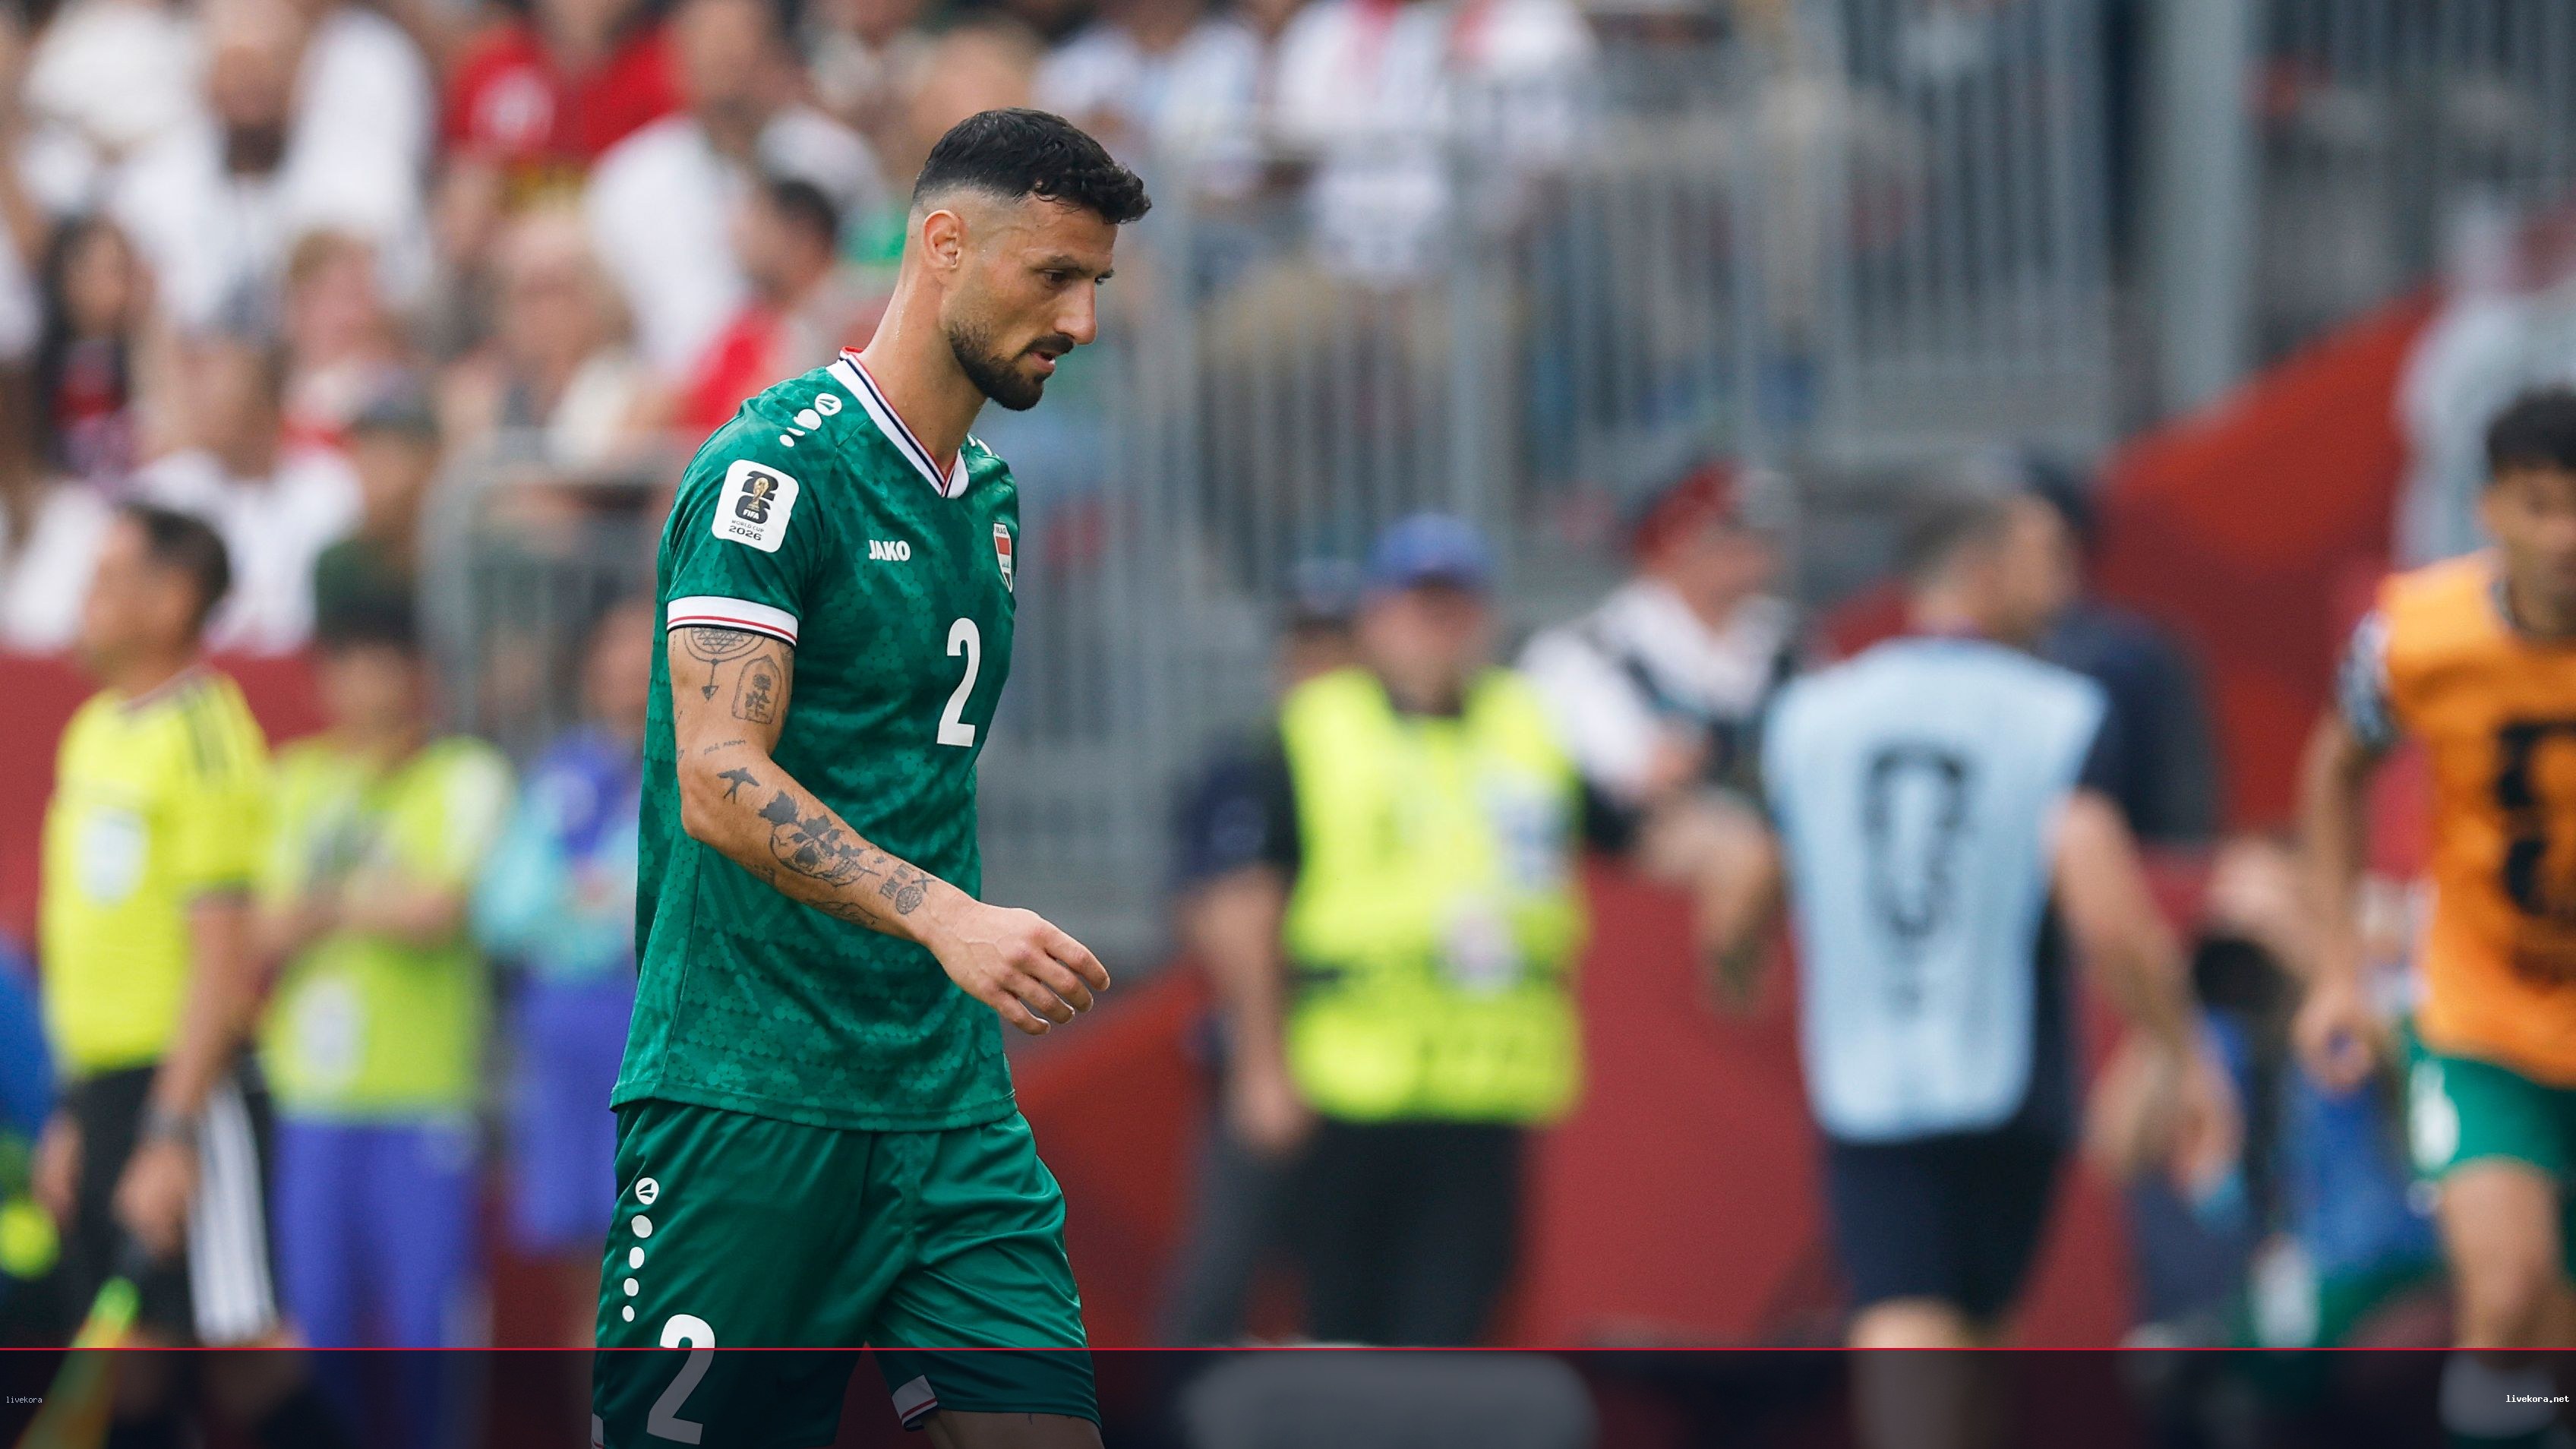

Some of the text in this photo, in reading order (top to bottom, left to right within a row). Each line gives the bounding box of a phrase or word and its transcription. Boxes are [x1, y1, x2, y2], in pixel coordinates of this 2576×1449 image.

[743, 508, 760, 519] FIFA
[728, 525, 762, 541] 2026
[731, 519, 752, 529] WORLD
[869, 539, 911, 561] JAKO
[936, 617, 980, 747] 2
[646, 1314, 715, 1444] 2
